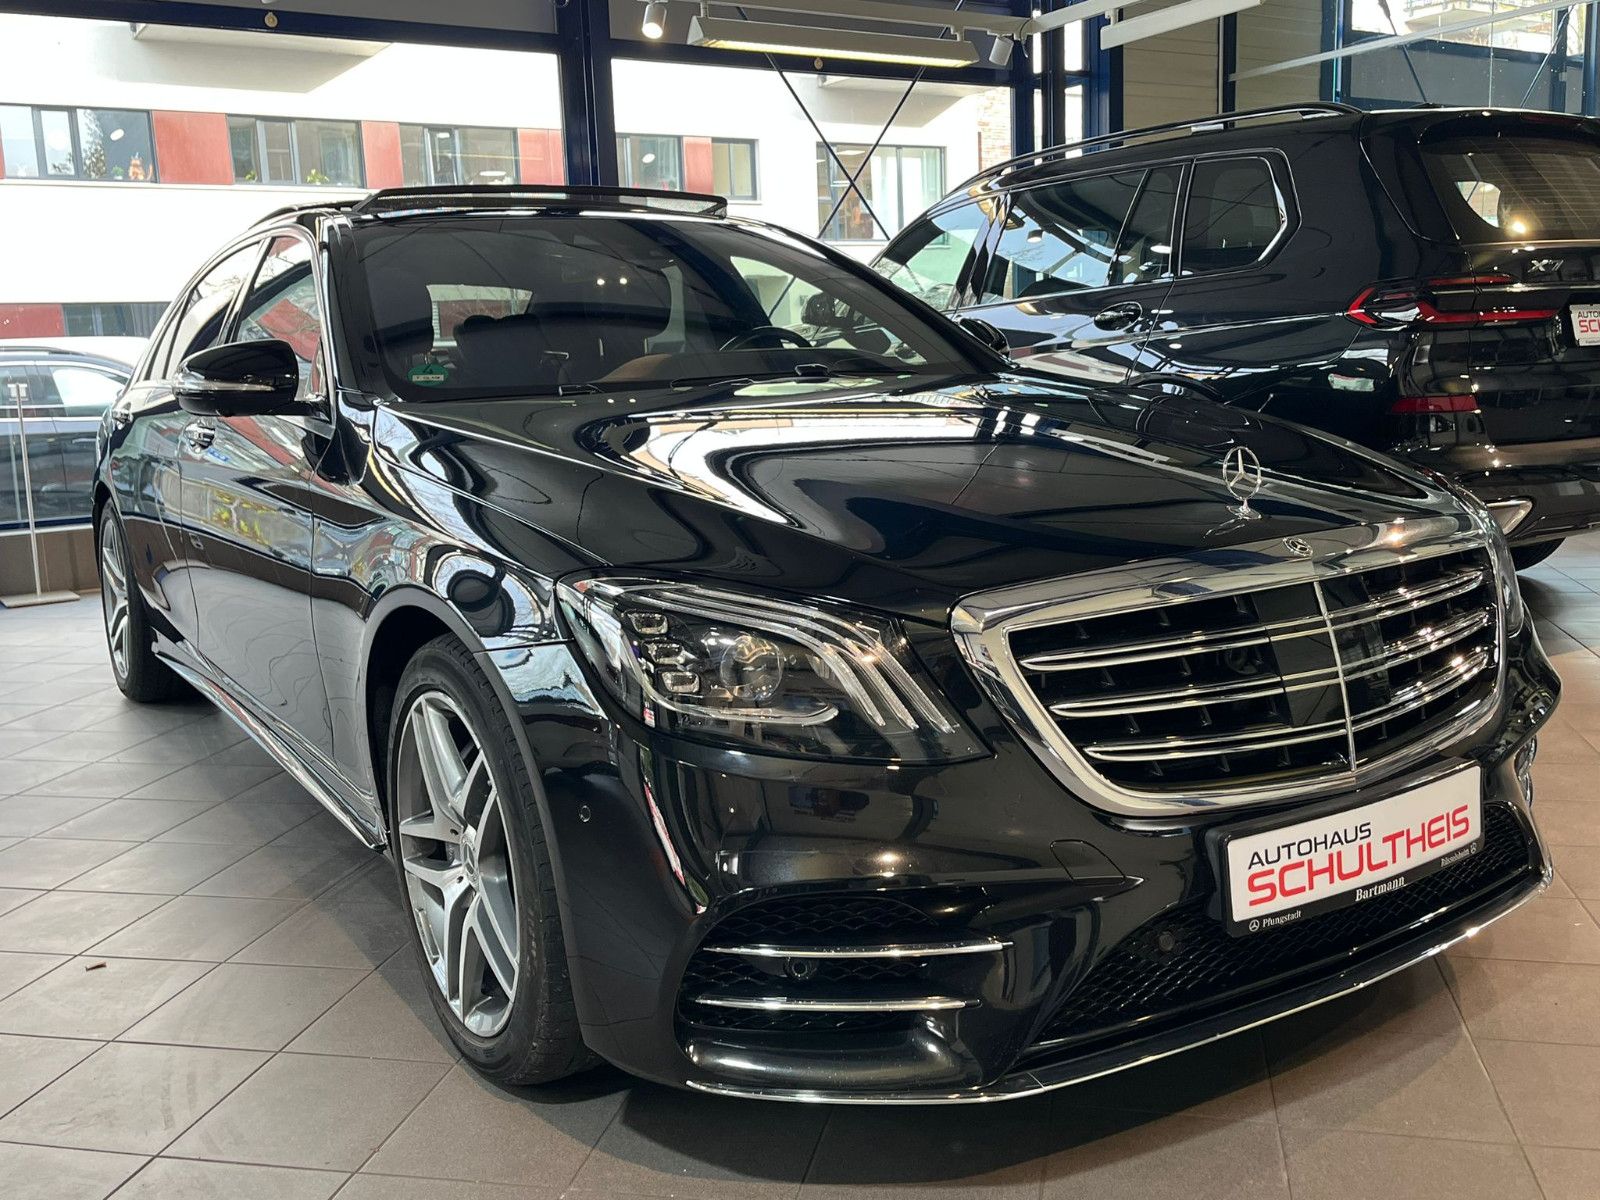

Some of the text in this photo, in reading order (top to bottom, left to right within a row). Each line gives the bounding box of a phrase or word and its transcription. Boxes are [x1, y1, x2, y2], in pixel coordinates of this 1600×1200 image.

[1527, 259, 1564, 273] X7
[1577, 310, 1600, 319] AUTO
[1247, 804, 1470, 907] SCHULTHEIS
[1248, 822, 1371, 870] AUTOHAUS
[1354, 876, 1405, 902] Bartmann
[1262, 910, 1301, 928] Pfungstadt
